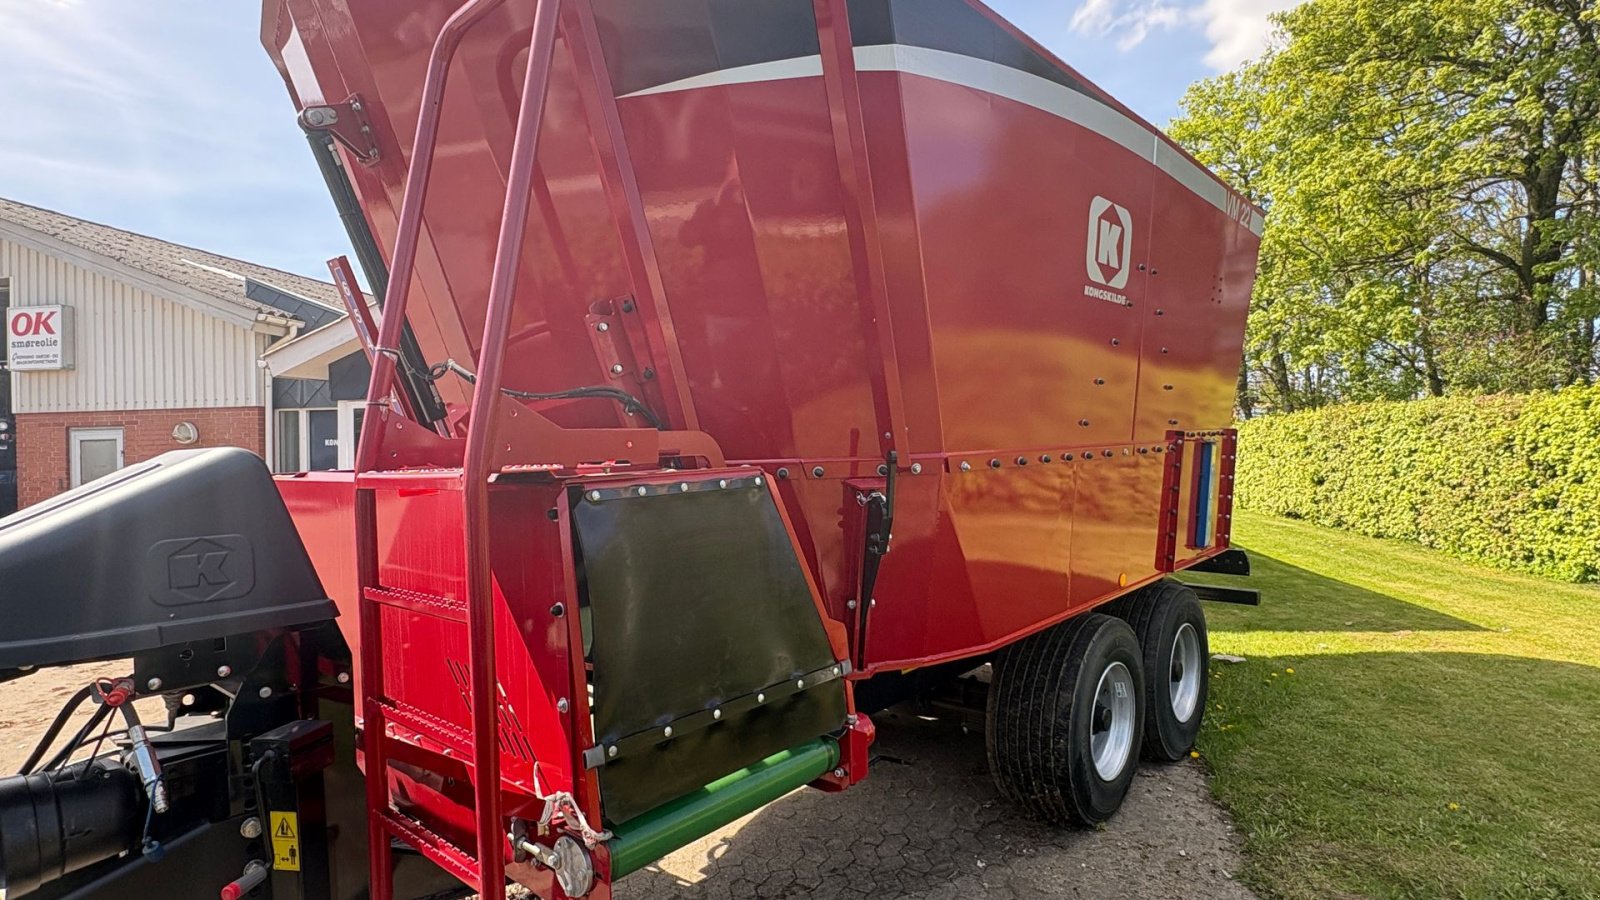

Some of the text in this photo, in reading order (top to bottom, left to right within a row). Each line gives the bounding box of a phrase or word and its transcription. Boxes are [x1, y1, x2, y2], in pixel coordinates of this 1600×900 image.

[1227, 190, 1250, 228] VM 22
[1084, 285, 1126, 305] KONGSKILDE
[11, 311, 58, 337] OK
[11, 337, 58, 348] smøreolie
